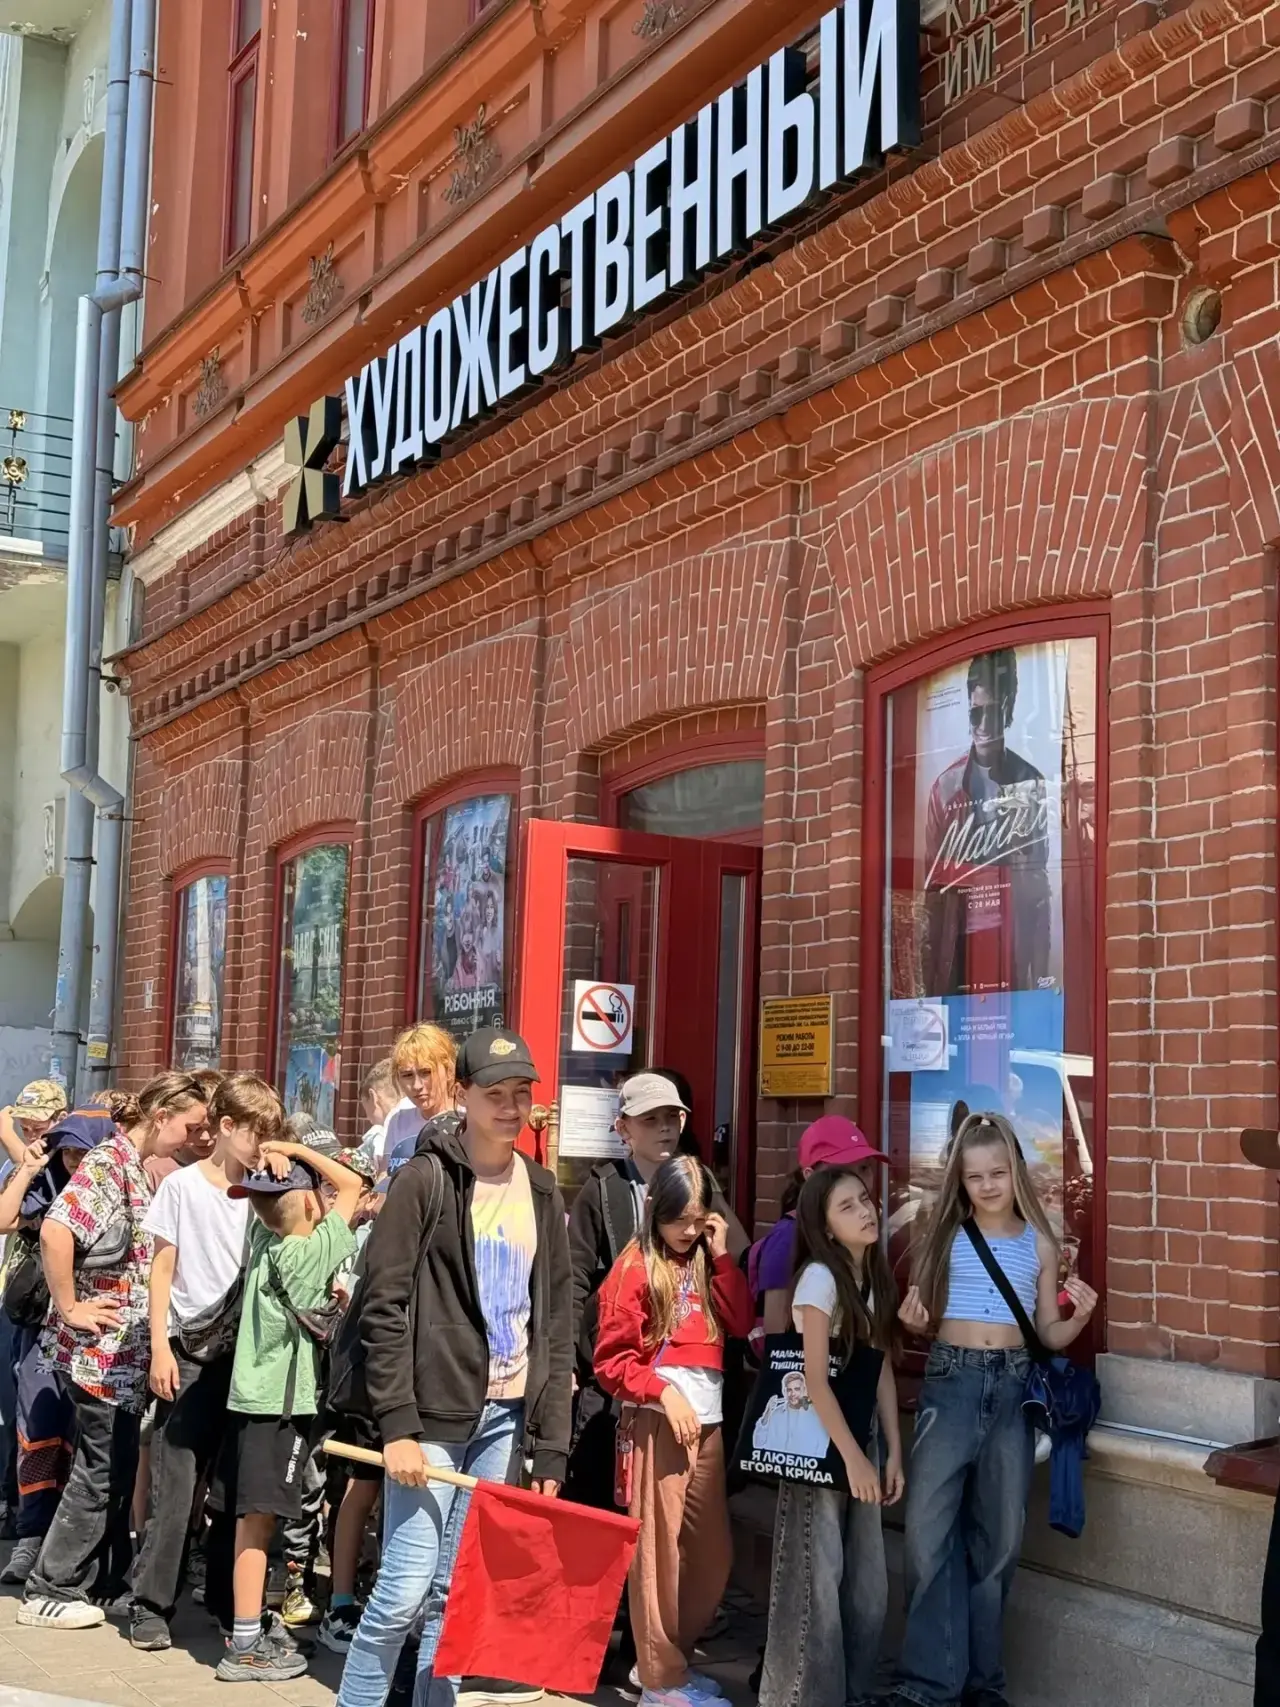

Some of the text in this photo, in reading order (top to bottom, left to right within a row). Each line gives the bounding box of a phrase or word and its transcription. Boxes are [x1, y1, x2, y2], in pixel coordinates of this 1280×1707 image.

[985, 899, 1001, 908] МАЯ
[444, 988, 495, 1013] РОБОНЯНЯ
[770, 1349, 804, 1359] МАЛЬЧ
[770, 1361, 806, 1371] ПИШИТ
[285, 1435, 302, 1484] SPORT VIBE
[752, 1450, 818, 1470] Я ЛЮБЛЮ
[740, 1460, 834, 1484] ЕГОРА КРИДА
